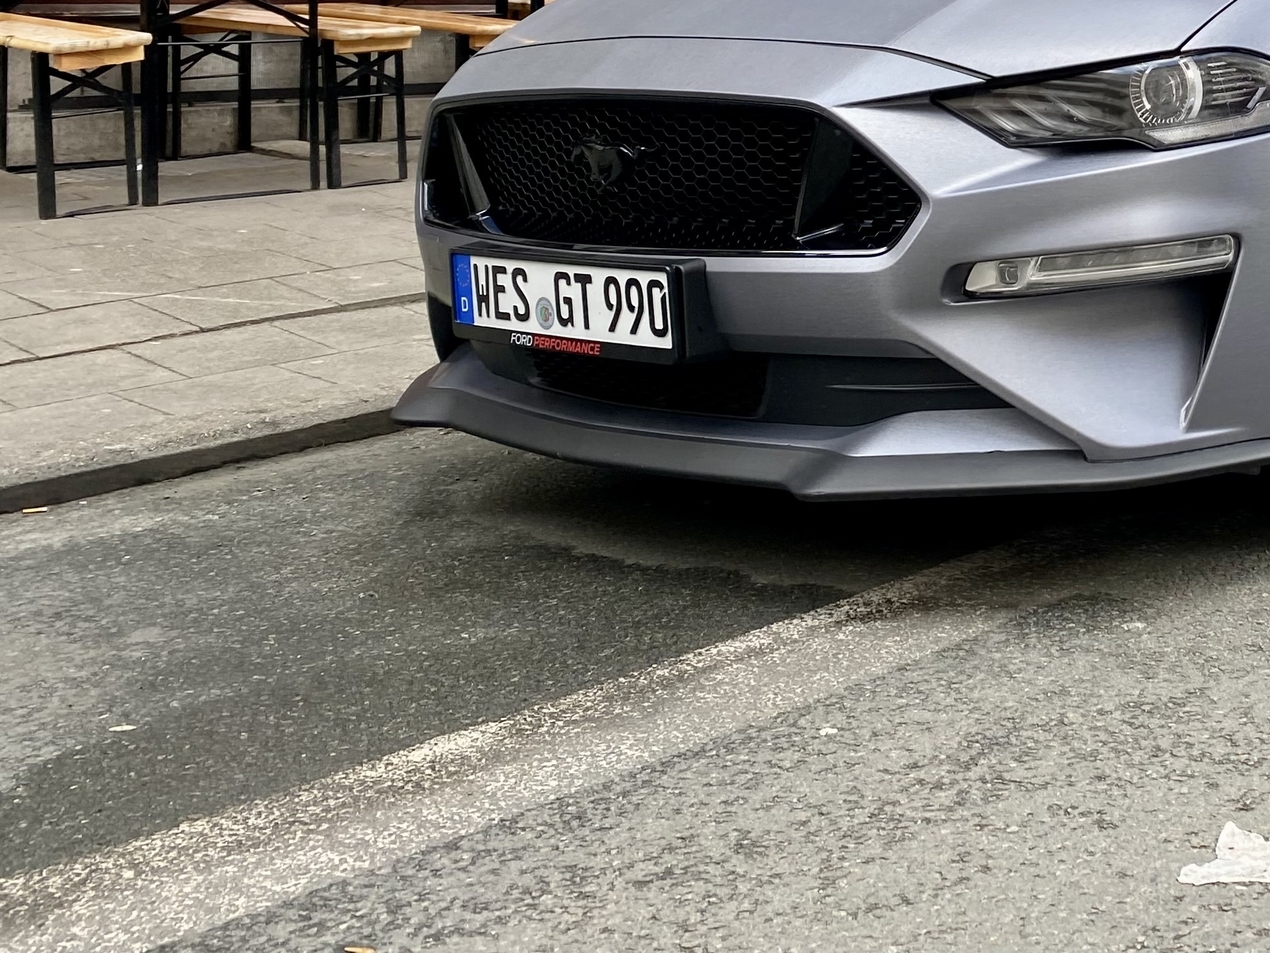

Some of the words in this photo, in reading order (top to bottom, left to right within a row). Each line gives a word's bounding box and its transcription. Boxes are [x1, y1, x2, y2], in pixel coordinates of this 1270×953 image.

[461, 297, 468, 312] D
[473, 263, 530, 322] WES
[553, 271, 592, 330] GT
[603, 275, 669, 338] 990
[510, 332, 533, 347] FORD
[533, 335, 600, 356] PERFORMANCE
